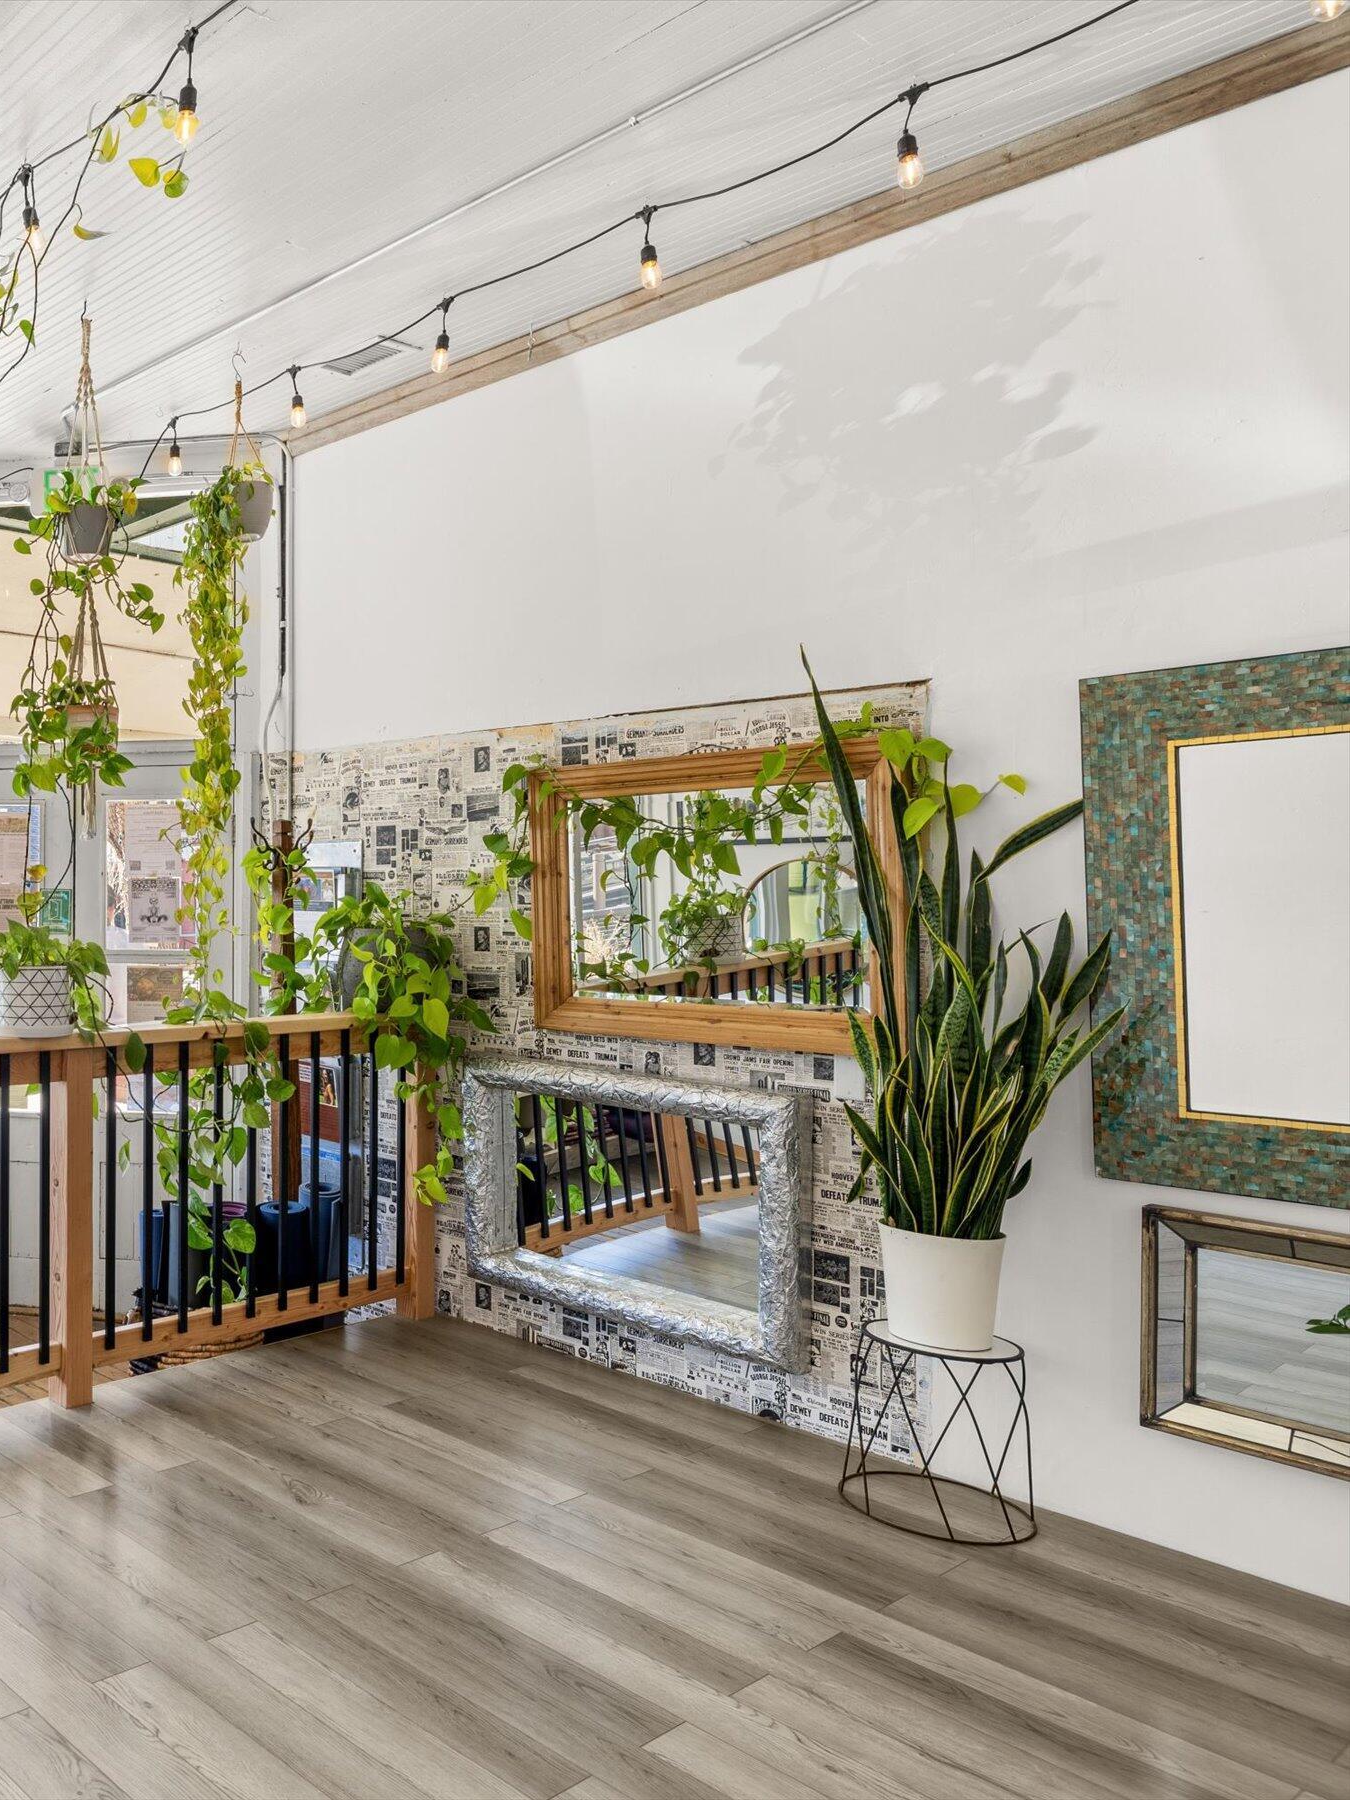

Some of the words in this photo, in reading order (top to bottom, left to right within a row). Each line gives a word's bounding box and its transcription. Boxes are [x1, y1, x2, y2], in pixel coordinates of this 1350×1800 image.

[873, 714, 889, 723] INTO
[546, 1047, 563, 1057] DEWEY
[567, 1049, 590, 1059] DEFEATS
[594, 1052, 618, 1062] TRUMAN
[723, 1053, 741, 1062] CROWD
[743, 1055, 757, 1063] JAMS
[759, 1056, 771, 1064] FAIR
[773, 1057, 794, 1067] OPENING
[831, 1172, 855, 1182] HOOVER
[821, 1189, 850, 1202] DEFEATS
[653, 1334, 685, 1350] SURRENDERS
[720, 1364, 741, 1374] DOLLAR
[641, 1371, 703, 1396] ILLUSTRATED
[829, 1396, 853, 1410] HOOVER
[790, 1403, 812, 1418] DEWEY
[818, 1412, 849, 1428] DEFEATS
